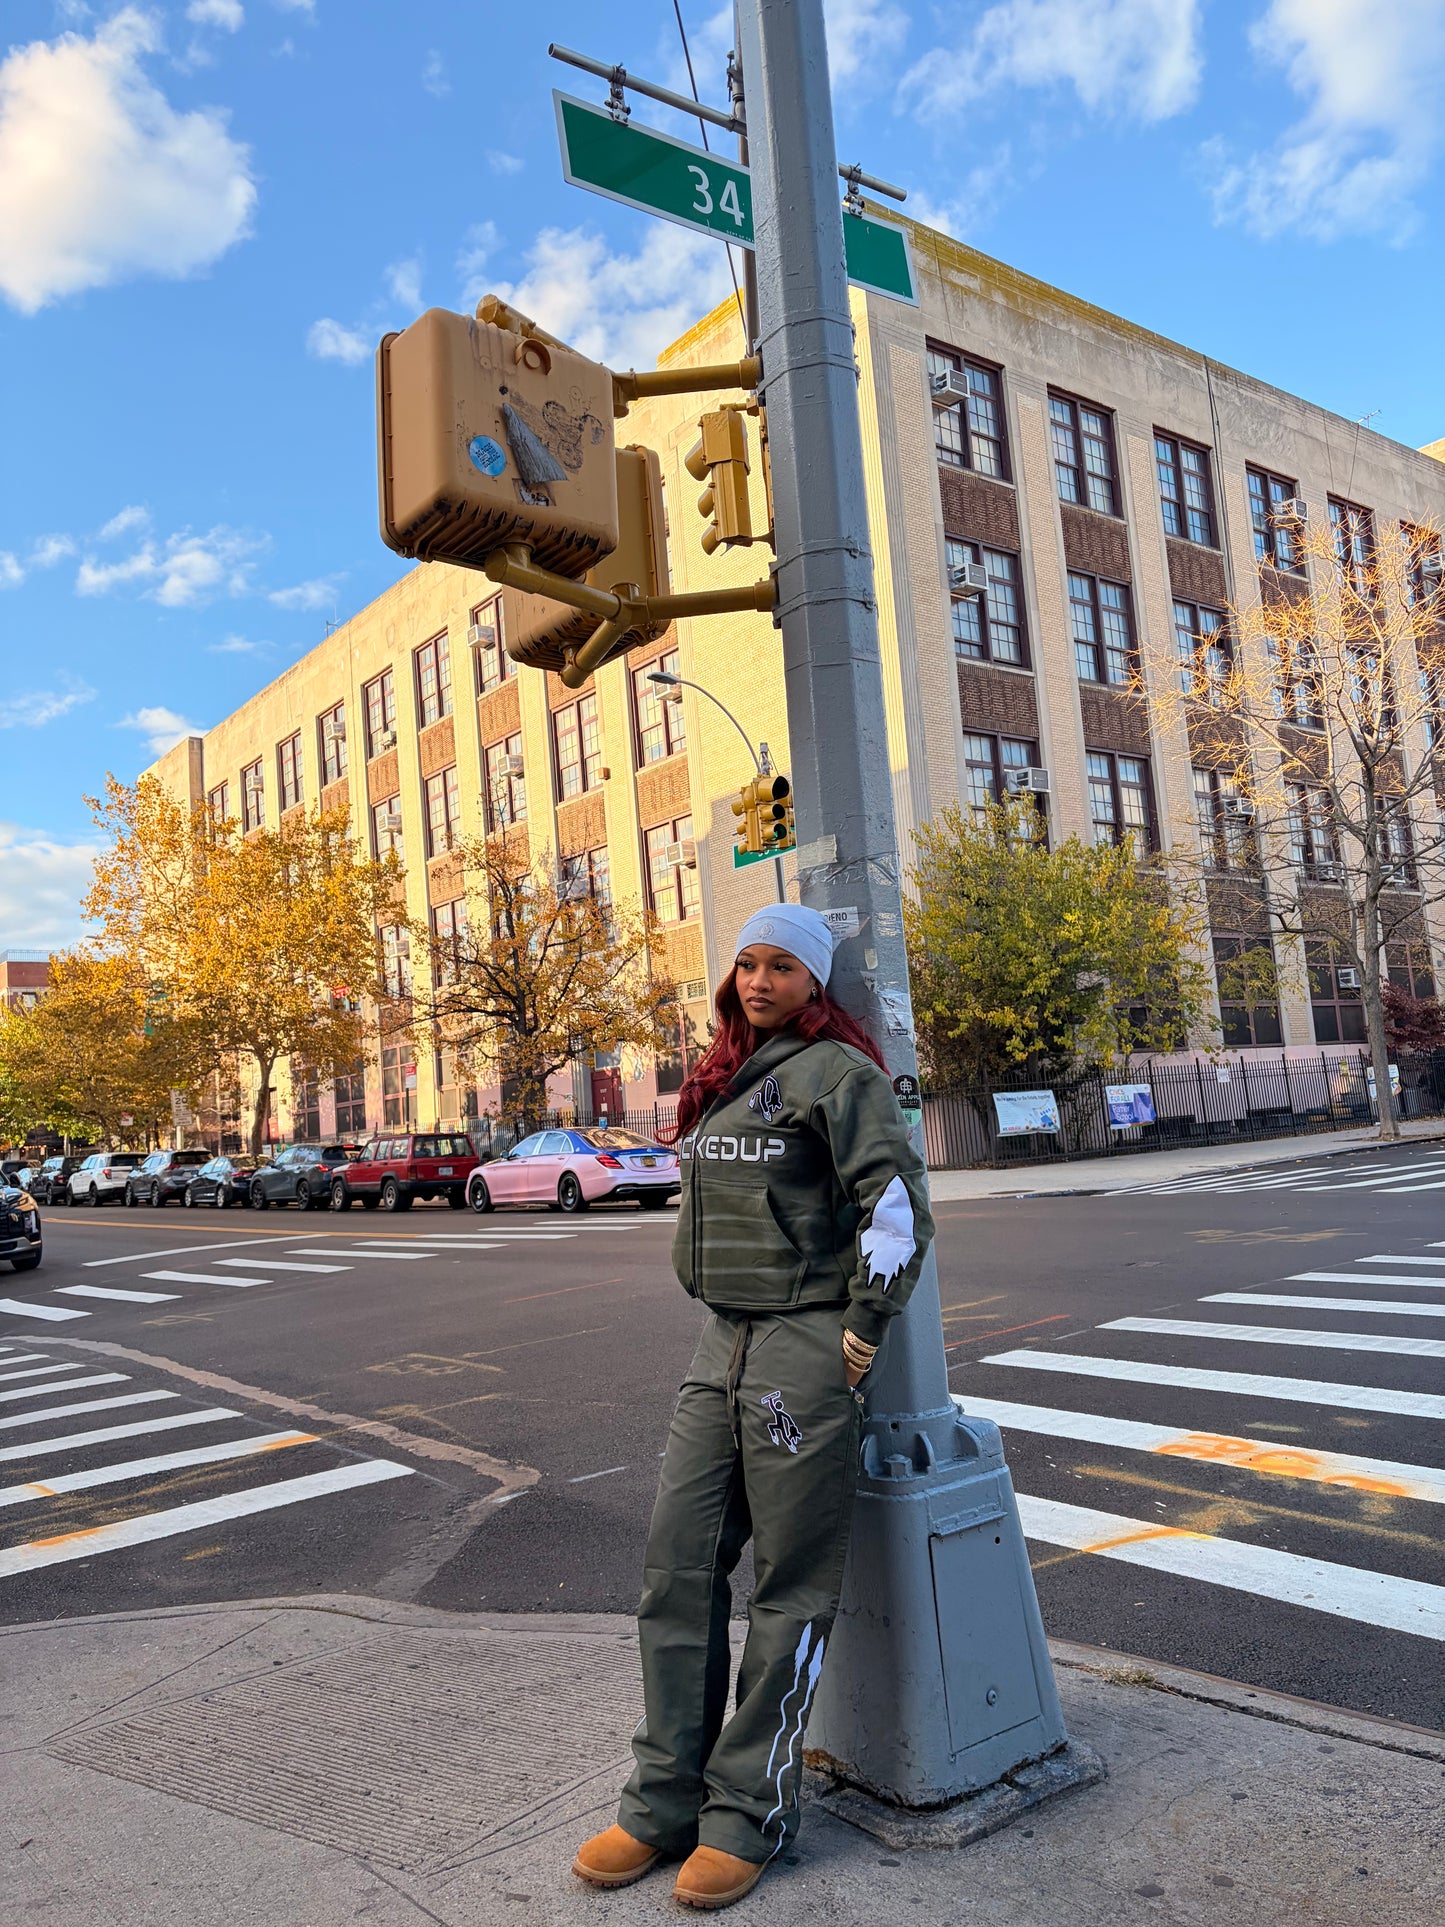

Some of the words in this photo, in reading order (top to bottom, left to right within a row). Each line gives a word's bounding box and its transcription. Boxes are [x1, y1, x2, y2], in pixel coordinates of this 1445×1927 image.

[687, 165, 745, 227] 34
[175, 1097, 188, 1105] 20
[680, 1135, 786, 1163] CKEDUP
